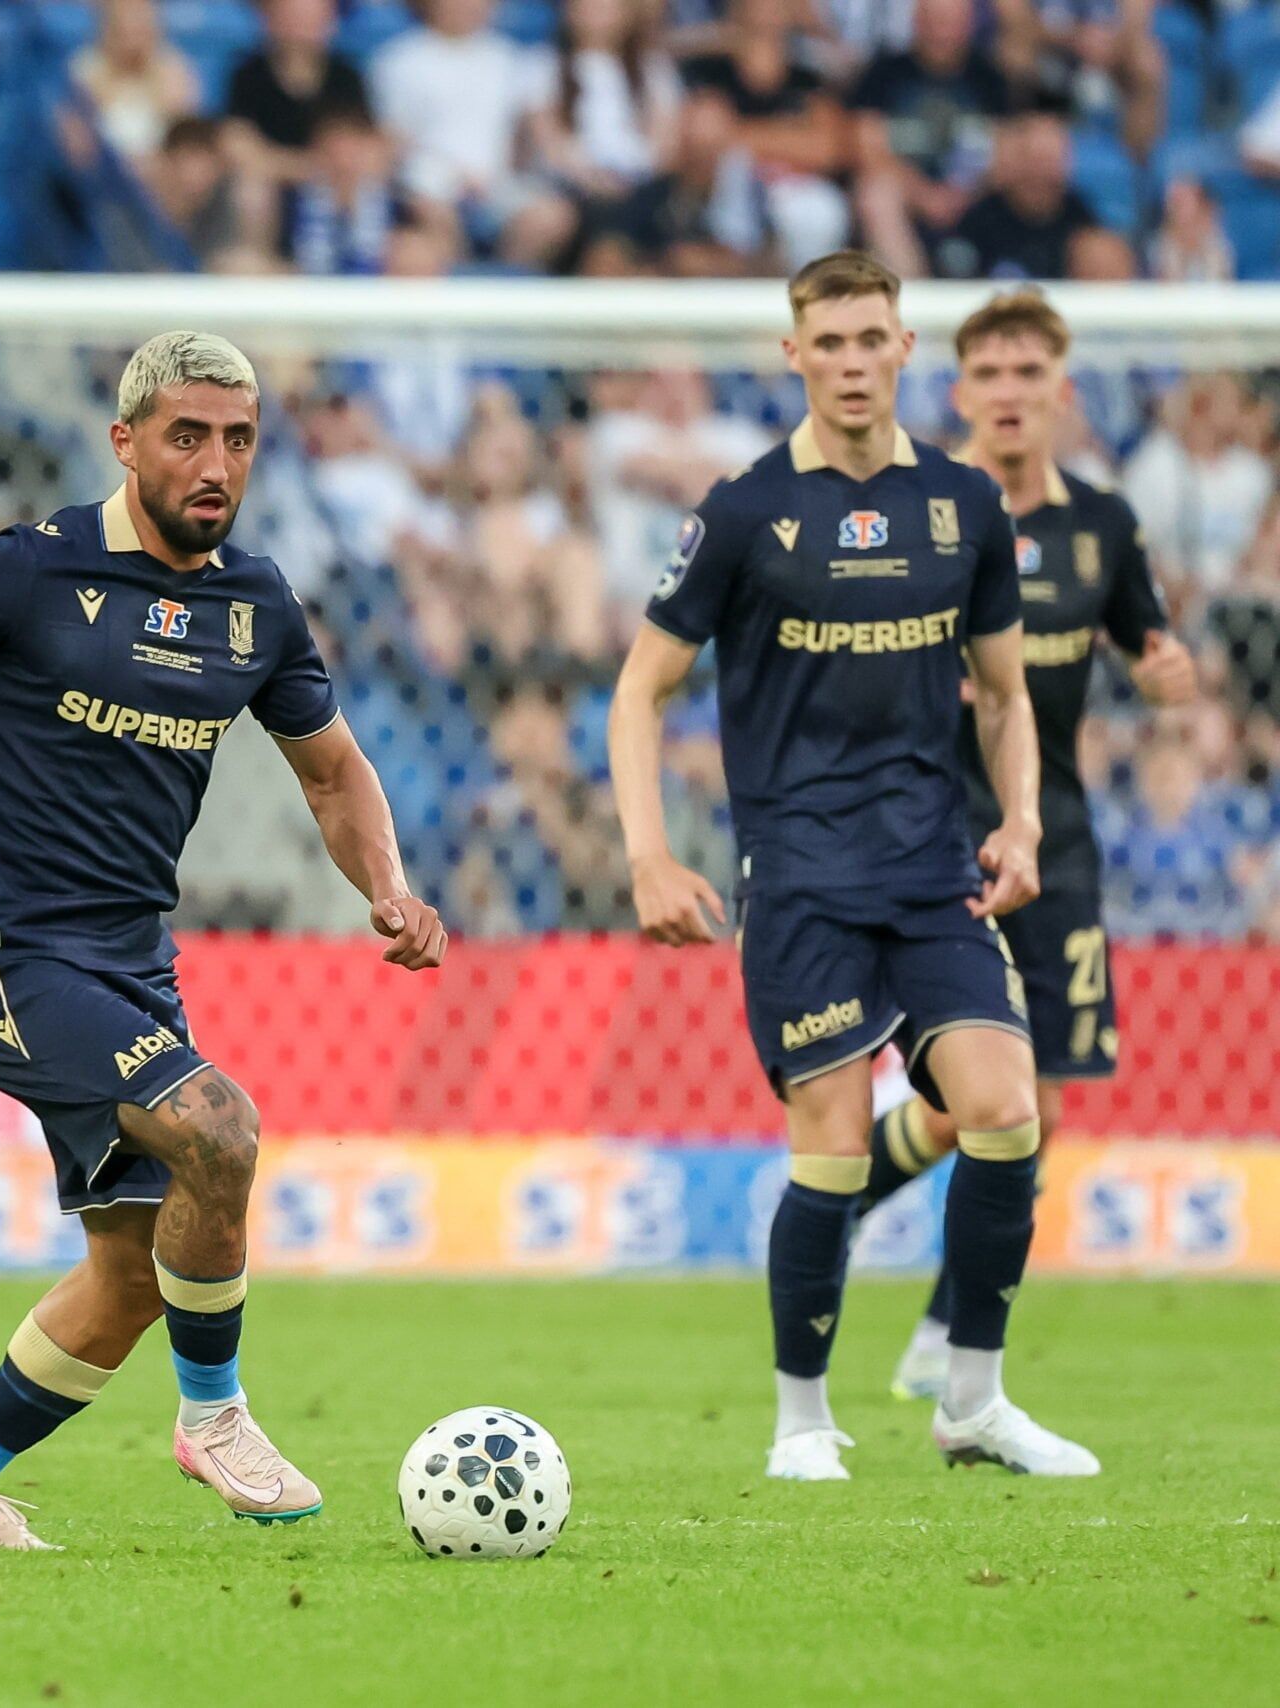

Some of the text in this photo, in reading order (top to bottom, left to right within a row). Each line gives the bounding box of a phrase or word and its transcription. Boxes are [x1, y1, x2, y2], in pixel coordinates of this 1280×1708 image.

[839, 510, 888, 549] STS
[144, 598, 192, 639] STS
[778, 607, 959, 653] SUPERBET
[57, 690, 232, 750] SUPERBET
